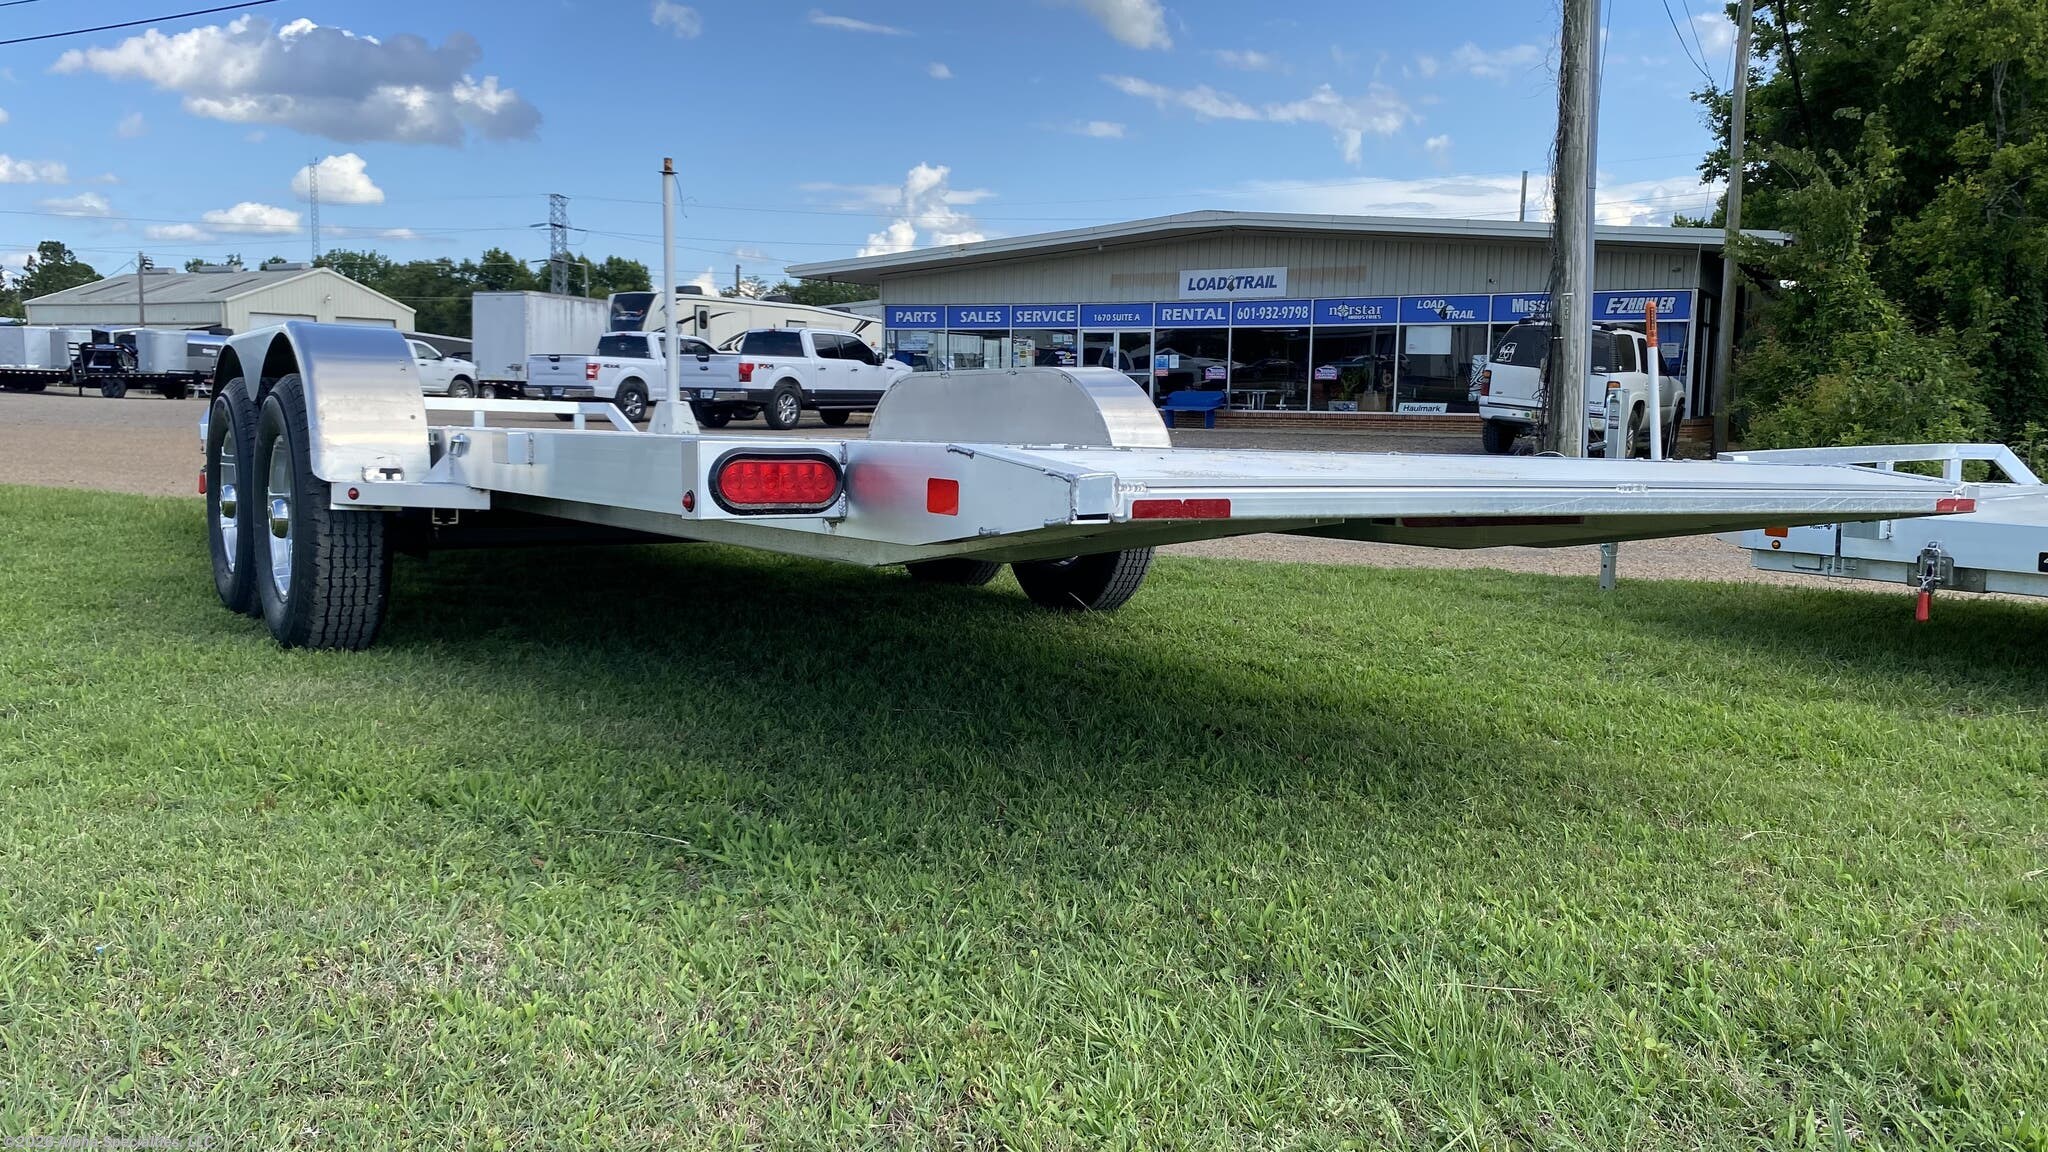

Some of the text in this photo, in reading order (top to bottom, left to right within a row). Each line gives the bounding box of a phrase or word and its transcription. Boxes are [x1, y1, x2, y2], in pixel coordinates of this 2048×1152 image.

[1187, 275, 1277, 291] LOAD TRAIL
[1417, 300, 1445, 309] LOAD
[895, 311, 937, 323] PARTS
[960, 310, 1002, 323] SALES
[1016, 310, 1075, 323] SERVICE
[1112, 313, 1133, 321] SUITE
[1134, 313, 1141, 321] A
[1161, 307, 1226, 321] RENTAL
[1237, 305, 1309, 320] 601-932-9798
[1446, 310, 1476, 319] TRAIL
[1402, 405, 1441, 413] Haulmark
